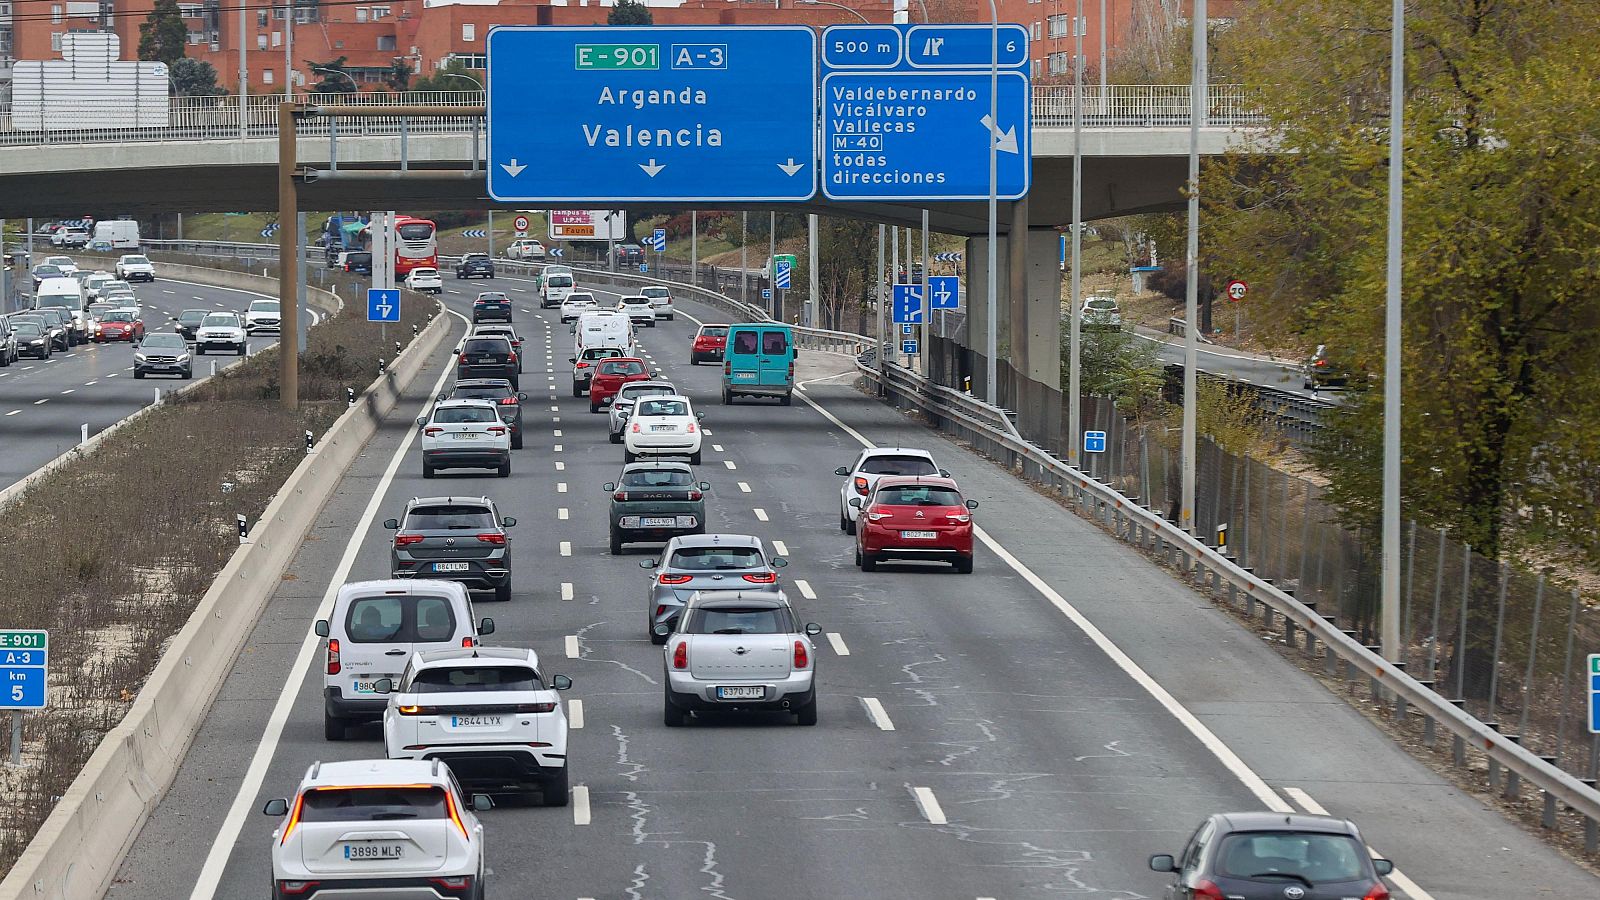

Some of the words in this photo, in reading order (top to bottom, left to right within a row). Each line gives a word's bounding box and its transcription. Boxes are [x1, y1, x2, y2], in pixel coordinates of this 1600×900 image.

[835, 41, 869, 53] 500
[877, 43, 891, 53] m
[1006, 41, 1016, 52] 6
[579, 48, 656, 66] E-901
[675, 47, 724, 66] A-3
[598, 86, 706, 109] Arganda
[833, 87, 977, 101] Valdebernardo
[833, 103, 927, 117] Vicálvaro
[833, 120, 916, 133] Vallecas
[582, 124, 722, 147] Valencia
[836, 136, 880, 148] M-40
[833, 153, 887, 167] todas
[833, 170, 946, 184] direcciones
[0, 635, 37, 646] E-901
[6, 652, 31, 664] A-3
[9, 671, 26, 681] km
[11, 685, 24, 701] 5
[723, 688, 744, 696] 6370
[746, 687, 761, 695] JTF
[458, 717, 481, 726] 2644
[484, 716, 501, 725] LYX
[351, 847, 378, 857] 3898
[382, 846, 402, 857] MLR
